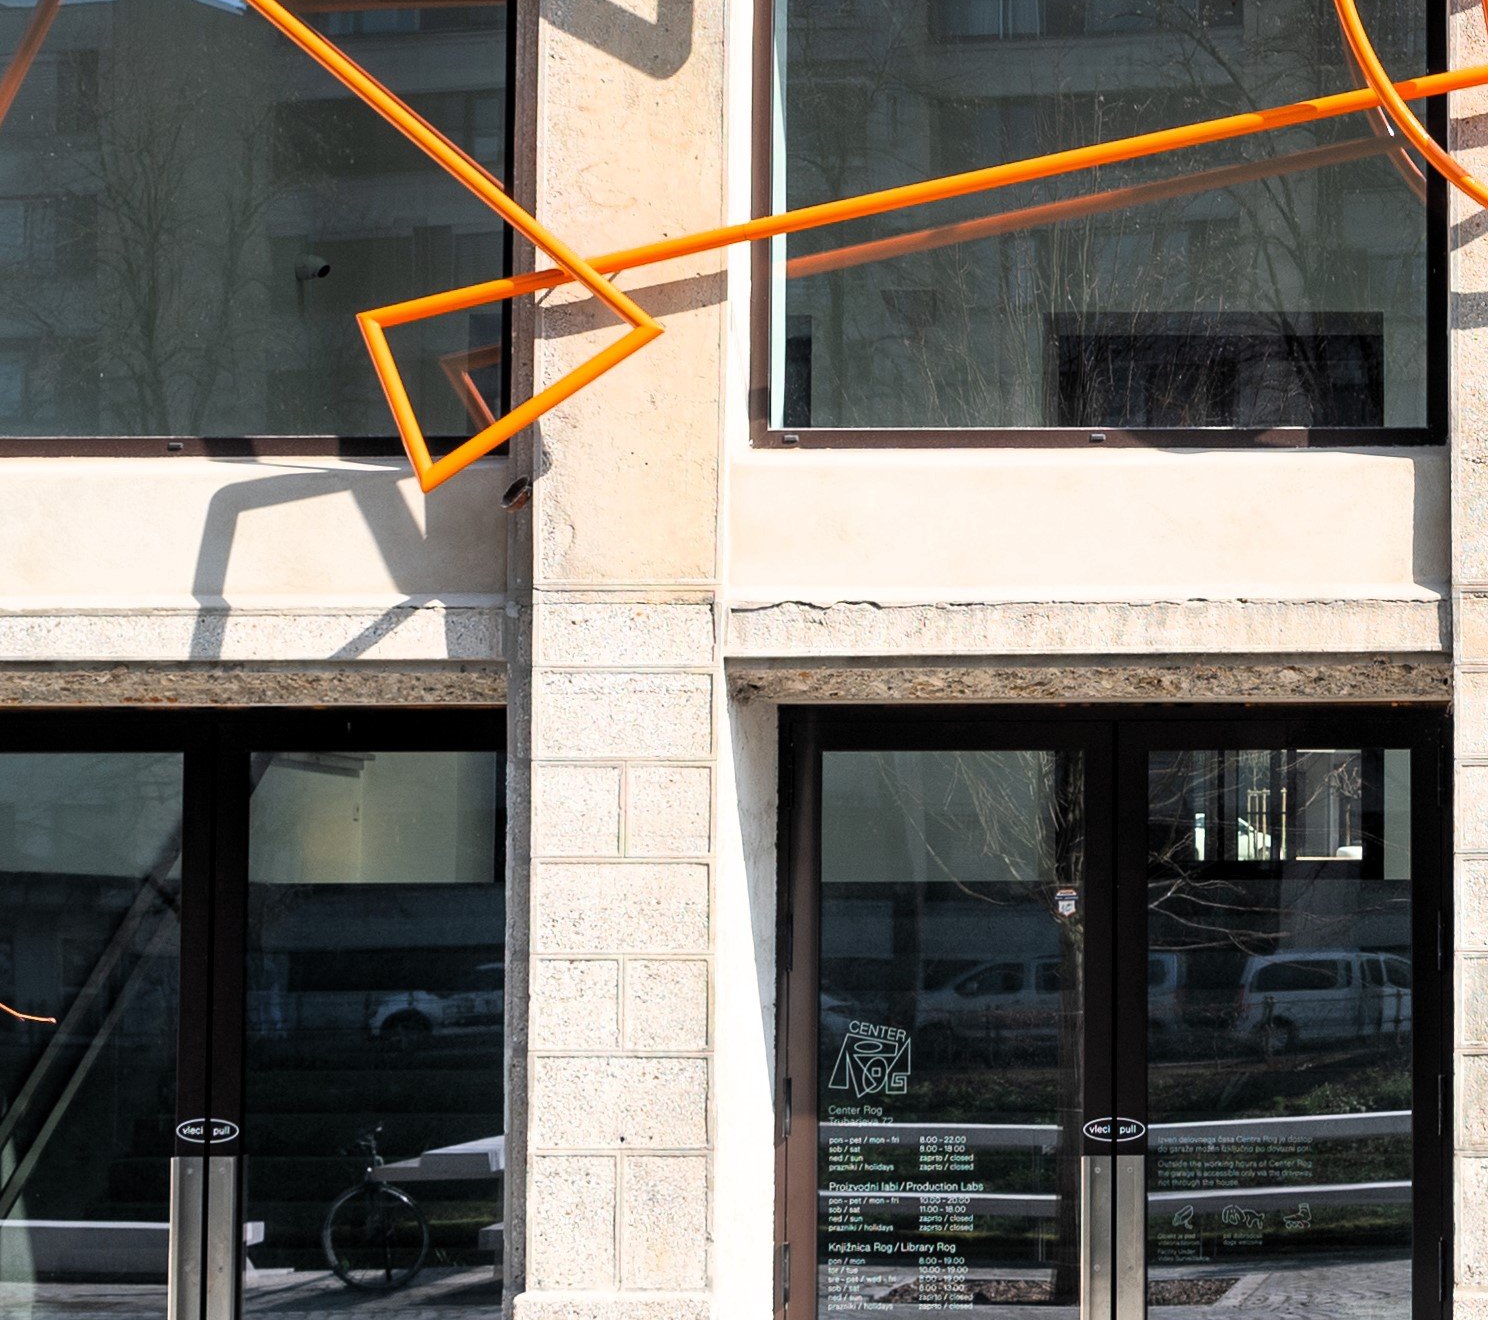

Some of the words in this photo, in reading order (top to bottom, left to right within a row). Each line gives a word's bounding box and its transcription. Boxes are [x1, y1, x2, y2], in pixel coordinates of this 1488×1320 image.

[849, 1020, 907, 1042] CENTER
[828, 1105, 860, 1115] Center
[863, 1105, 883, 1117] Rog
[881, 1117, 893, 1125] 72
[182, 1126, 204, 1135] vleci
[212, 1126, 231, 1136] pull
[1088, 1124, 1111, 1134] vleci
[1119, 1124, 1137, 1134] pull
[829, 1182, 879, 1191] Proizvodni
[881, 1182, 899, 1191] labi
[906, 1182, 958, 1192] Production
[961, 1182, 984, 1192] Labs
[828, 1242, 871, 1254] Knjižnica
[874, 1242, 893, 1254] Rog
[901, 1242, 934, 1254] Library
[937, 1242, 956, 1254] Rog
